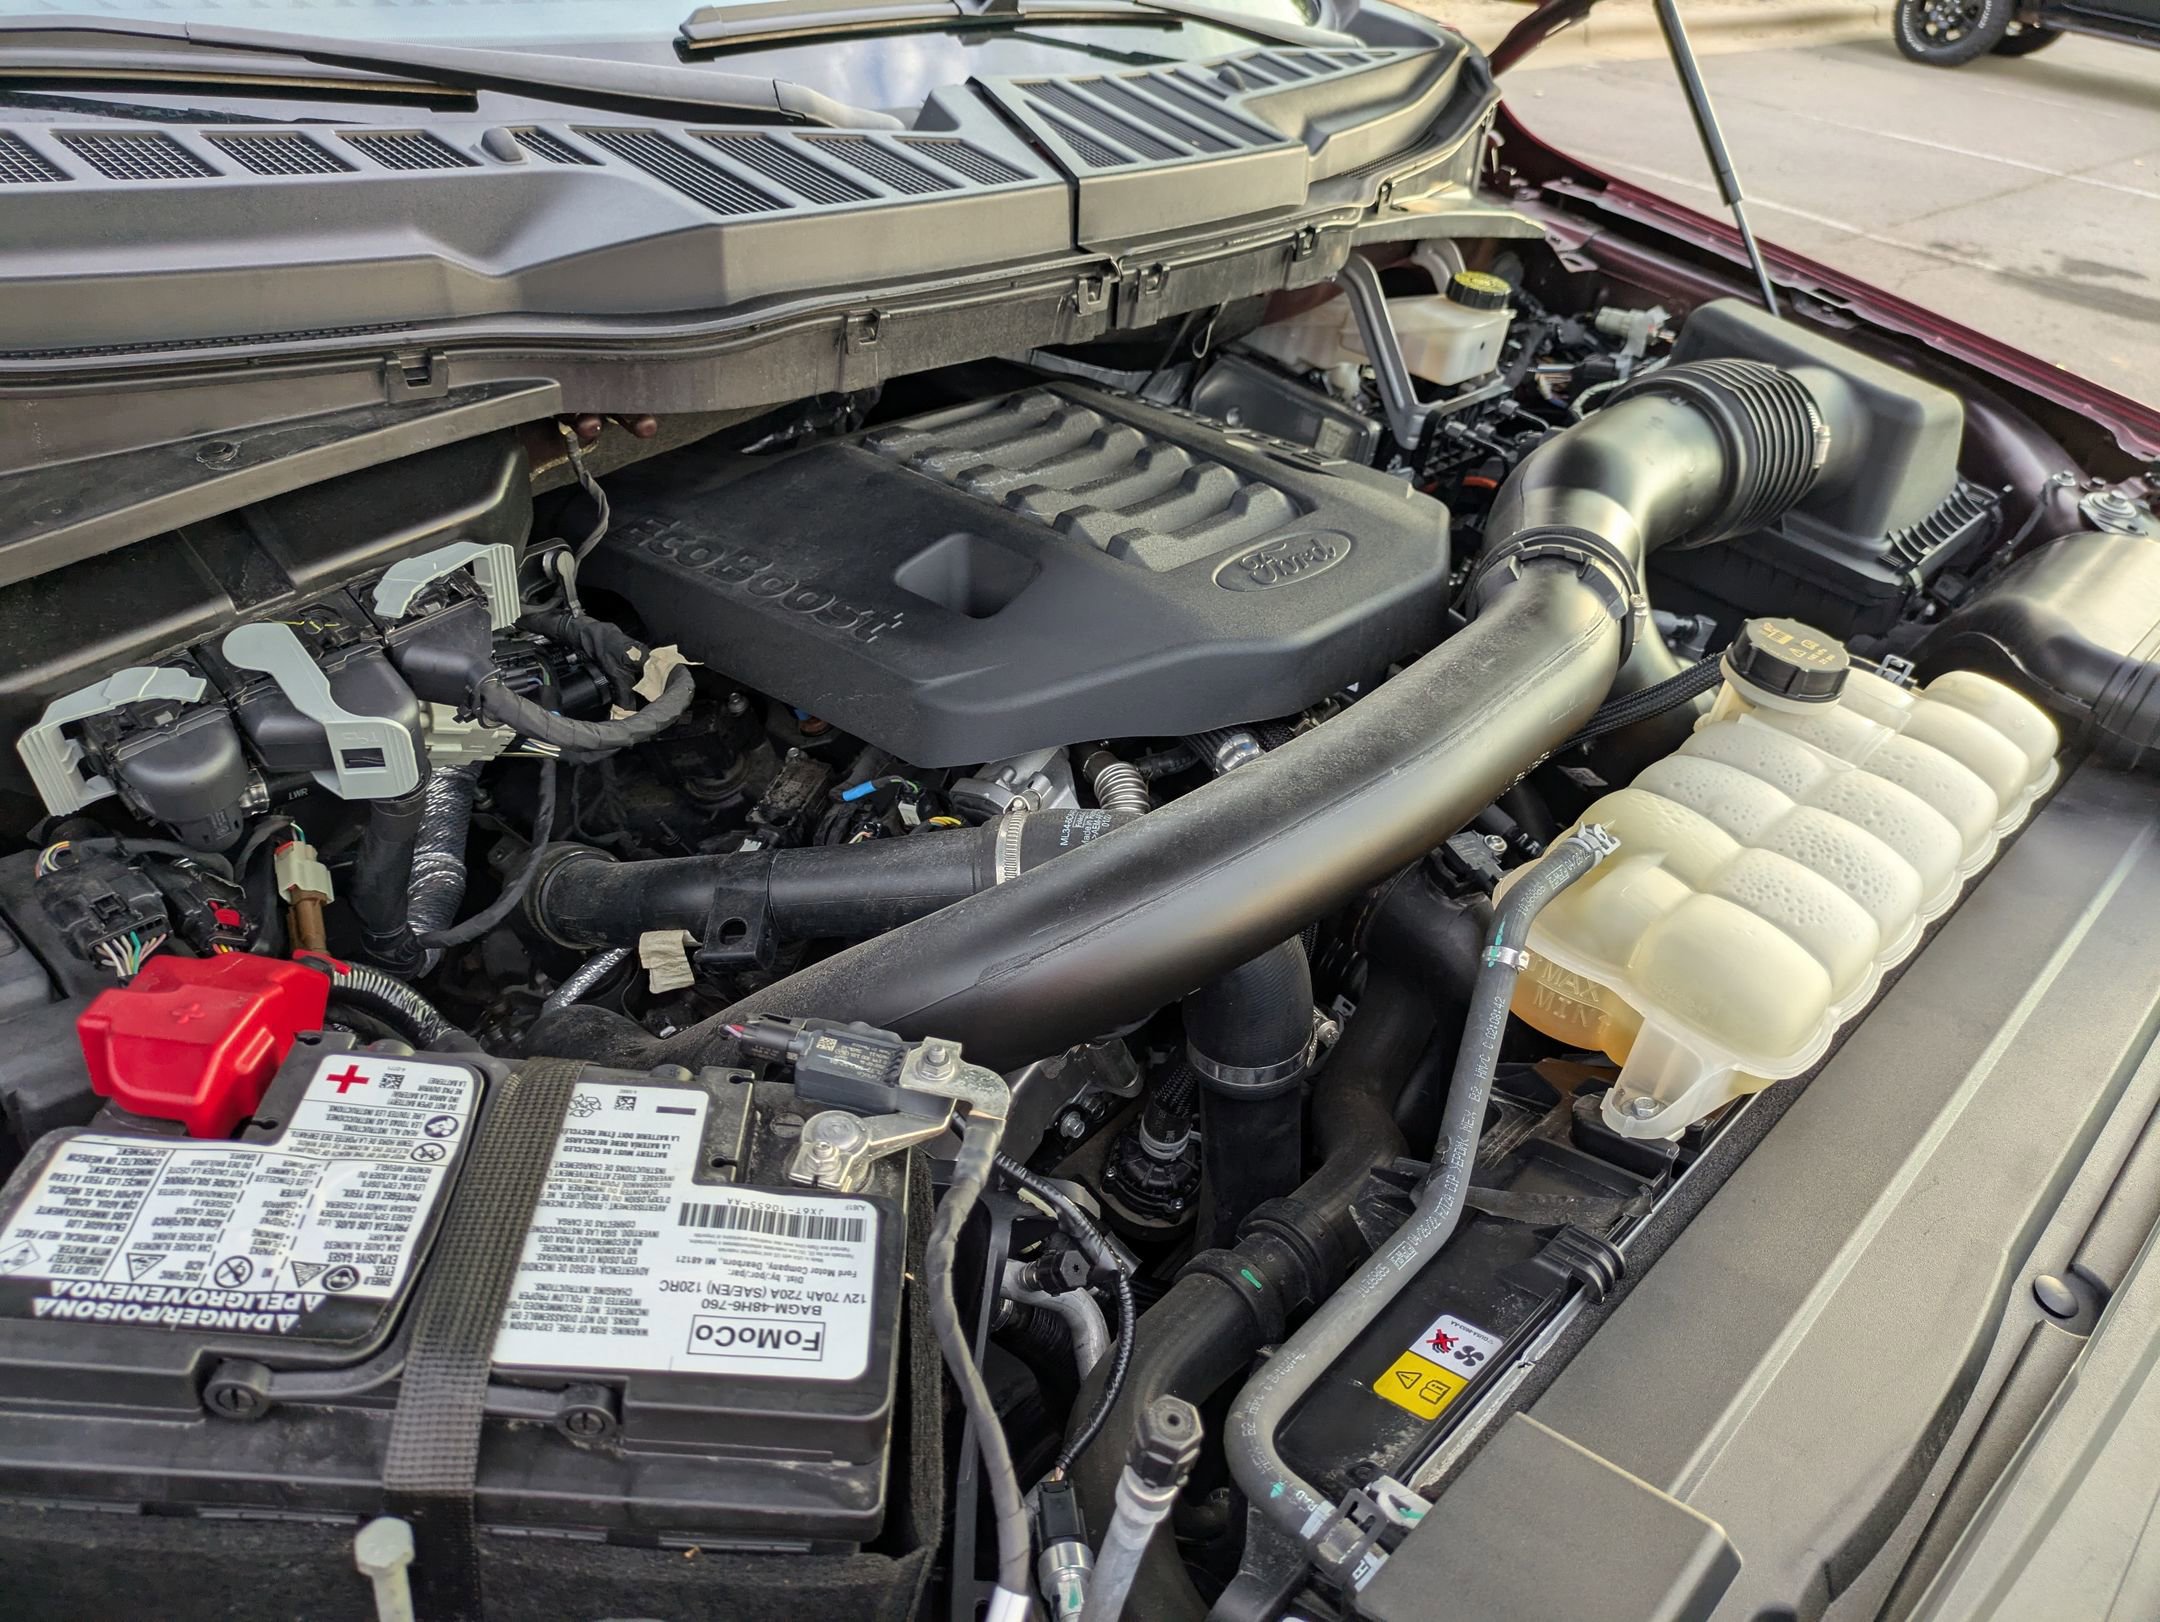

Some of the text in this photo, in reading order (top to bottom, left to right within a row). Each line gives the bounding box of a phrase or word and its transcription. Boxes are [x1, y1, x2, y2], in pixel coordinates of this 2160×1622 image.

[1239, 538, 1336, 585] Ford
[616, 518, 903, 644] EcoBoost
[288, 787, 309, 801] LWR
[1541, 961, 1600, 1003] MAX
[1532, 985, 1589, 1028] MIN
[1458, 1110, 1479, 1135] MEX
[1469, 1087, 1484, 1103] B2
[1485, 995, 1507, 1041] 02:08:42
[676, 1255, 702, 1264] 48121
[705, 1257, 716, 1265] MI
[811, 1267, 835, 1276] Motor
[838, 1269, 857, 1278] Ford
[71, 1282, 302, 1312] PELIGRO/VENENO
[659, 1280, 867, 1304] 12V 70Ah 720A (SAE/EN) 120RC
[700, 1298, 822, 1316] BAGM-48H6-760
[53, 1298, 275, 1330] DANGER/POISON
[694, 1323, 821, 1353] FoMoCo
